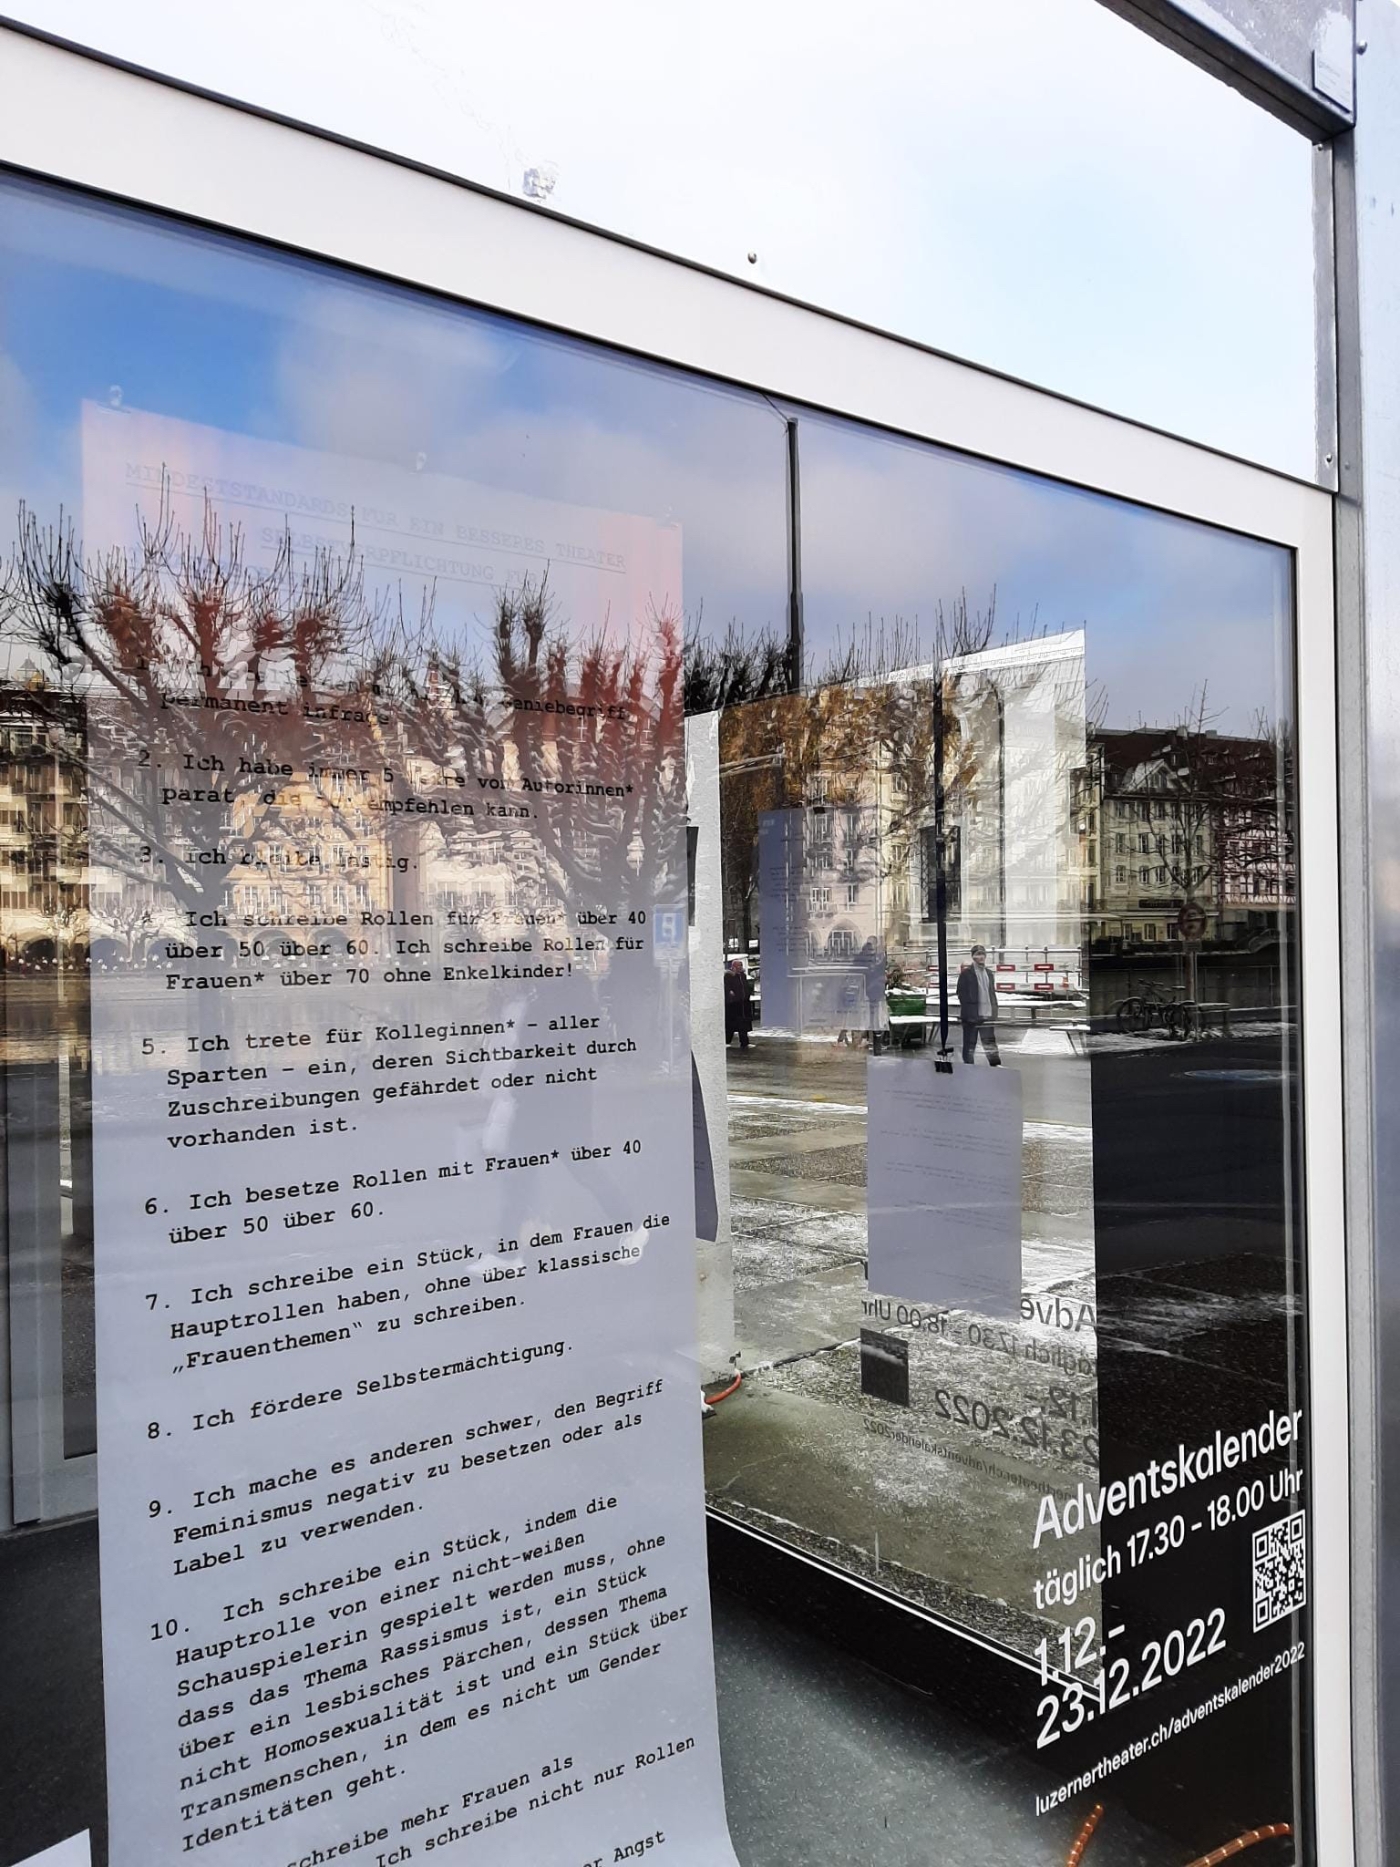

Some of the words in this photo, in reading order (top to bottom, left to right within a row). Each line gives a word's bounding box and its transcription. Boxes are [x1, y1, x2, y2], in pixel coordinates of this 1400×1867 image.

[556, 543, 625, 568] THEATER
[161, 694, 288, 715] permanent
[139, 750, 162, 767] 2.
[183, 754, 225, 771] Ich
[240, 758, 293, 775] habe
[384, 768, 393, 782] 5
[486, 802, 538, 819] kann.
[140, 846, 164, 863] 3.
[165, 943, 223, 959] über
[239, 941, 265, 957] 50
[279, 941, 331, 957] über
[346, 939, 379, 955] 60.
[397, 940, 430, 954] Ich
[444, 939, 532, 953] schreibe
[543, 939, 610, 952] Rollen
[616, 937, 645, 950] für
[186, 911, 227, 927] Ich
[244, 910, 347, 927] schreibe
[361, 911, 433, 926] Rollen
[577, 912, 618, 925] über
[628, 911, 646, 924] 40
[280, 971, 332, 986] über
[346, 969, 370, 984] 70
[384, 967, 431, 982] ohne
[443, 963, 572, 981] Enkelkinder!
[142, 1038, 166, 1055] 5.
[187, 1035, 230, 1052] Ich
[246, 1033, 311, 1049] trete
[326, 1028, 362, 1044] für
[549, 1015, 600, 1030] aller
[167, 1067, 267, 1089] Sparten
[308, 1059, 357, 1075] ein,
[372, 1055, 433, 1070] deren
[446, 1043, 576, 1065] Sichtbarkeit
[586, 1039, 637, 1054] durch
[168, 1090, 360, 1117] Zuschreibungen
[373, 1077, 480, 1103] gefährdet
[491, 1073, 534, 1089] oder
[545, 1067, 598, 1084] nicht
[145, 1198, 169, 1214] 6.
[190, 1191, 232, 1210] Ich
[245, 1180, 340, 1204] besetze
[352, 1168, 427, 1189] Rollen
[438, 1161, 474, 1178] mit
[571, 1145, 611, 1161] über
[623, 1139, 642, 1154] 40
[145, 1294, 171, 1310] 7.
[191, 1285, 233, 1304] Ich
[248, 1267, 353, 1295] schreibe
[367, 1258, 404, 1275] ein
[417, 1245, 484, 1267] Stück,
[498, 1239, 518, 1253] in
[530, 1232, 563, 1248] dem
[573, 1222, 633, 1241] Frauen
[643, 1215, 670, 1230] die
[170, 1301, 324, 1339] Hauptrollen
[337, 1288, 409, 1310] haben,
[425, 1276, 471, 1294] ohne
[483, 1265, 527, 1283] über
[538, 1246, 641, 1274] klassische
[377, 1317, 401, 1332] zu
[414, 1295, 525, 1325] schreiben.
[148, 1422, 172, 1439] 8.
[193, 1409, 235, 1431] Ich
[250, 1388, 343, 1419] fördere
[357, 1339, 573, 1395] Selbstermächtigung.
[149, 1500, 172, 1518] 9.
[193, 1485, 235, 1508] Ich
[249, 1467, 317, 1495] mache
[331, 1458, 356, 1474] es
[369, 1433, 453, 1465] anderen
[466, 1414, 541, 1440] schwer,
[554, 1402, 586, 1419] den
[596, 1379, 663, 1409] Begriff
[174, 1499, 313, 1544] Feminismus
[326, 1470, 415, 1505] negativ
[427, 1463, 450, 1479] zu
[461, 1438, 551, 1470] besetzen
[562, 1424, 603, 1444] oder
[614, 1413, 642, 1431] als
[1033, 1409, 1303, 1549] Adventskalender
[151, 1619, 190, 1641] 10.
[223, 1598, 264, 1622] Ich
[279, 1565, 382, 1606] schreibe
[394, 1551, 430, 1571] ein
[443, 1529, 509, 1557] Stück,
[524, 1508, 577, 1534] indem
[586, 1496, 618, 1515] die
[1033, 1545, 1121, 1610] täglich
[1127, 1515, 1185, 1568] 17.30
[1207, 1480, 1265, 1531] 18.00
[1269, 1468, 1303, 1502] Uhr
[176, 1616, 316, 1666] Hauptrolle
[328, 1601, 367, 1620] von
[380, 1576, 440, 1604] einer
[452, 1532, 586, 1583] nicht-weißen
[178, 1629, 368, 1697] Schauspielerin
[380, 1593, 477, 1638] gespielt
[489, 1570, 554, 1600] werden
[564, 1553, 615, 1576] muss,
[626, 1535, 665, 1556] ohne
[178, 1701, 234, 1728] dass
[249, 1684, 289, 1706] das
[303, 1658, 368, 1689] Thema
[380, 1618, 488, 1664] Rassismus
[501, 1604, 541, 1625] ist,
[554, 1588, 586, 1605] ein
[597, 1564, 647, 1592] Stück
[178, 1731, 235, 1759] über
[250, 1714, 291, 1737] ein
[305, 1670, 430, 1718] lesbisches
[442, 1636, 532, 1672] Pärchen,
[544, 1607, 608, 1637] dessen
[618, 1586, 668, 1613] Thema
[1036, 1607, 1226, 1750] 23.12.2022
[180, 1750, 367, 1821] Transmenschen,
[384, 1732, 408, 1751] in
[420, 1715, 457, 1738] dem
[467, 1702, 490, 1720] es
[502, 1678, 557, 1709] nicht
[567, 1667, 589, 1684] um
[599, 1642, 661, 1673] Gender
[1035, 1642, 1306, 1816] luzernertheater.ch/adventskalender2022
[376, 1846, 412, 1867] Ich
[424, 1806, 517, 1851] schreibe
[528, 1779, 584, 1811] nicht
[593, 1763, 625, 1785] nur
[635, 1736, 695, 1770] Rollen
[401, 1804, 450, 1832] mehr
[461, 1774, 530, 1809] Frauen
[541, 1755, 574, 1778] als
[613, 1830, 666, 1862] Angst
